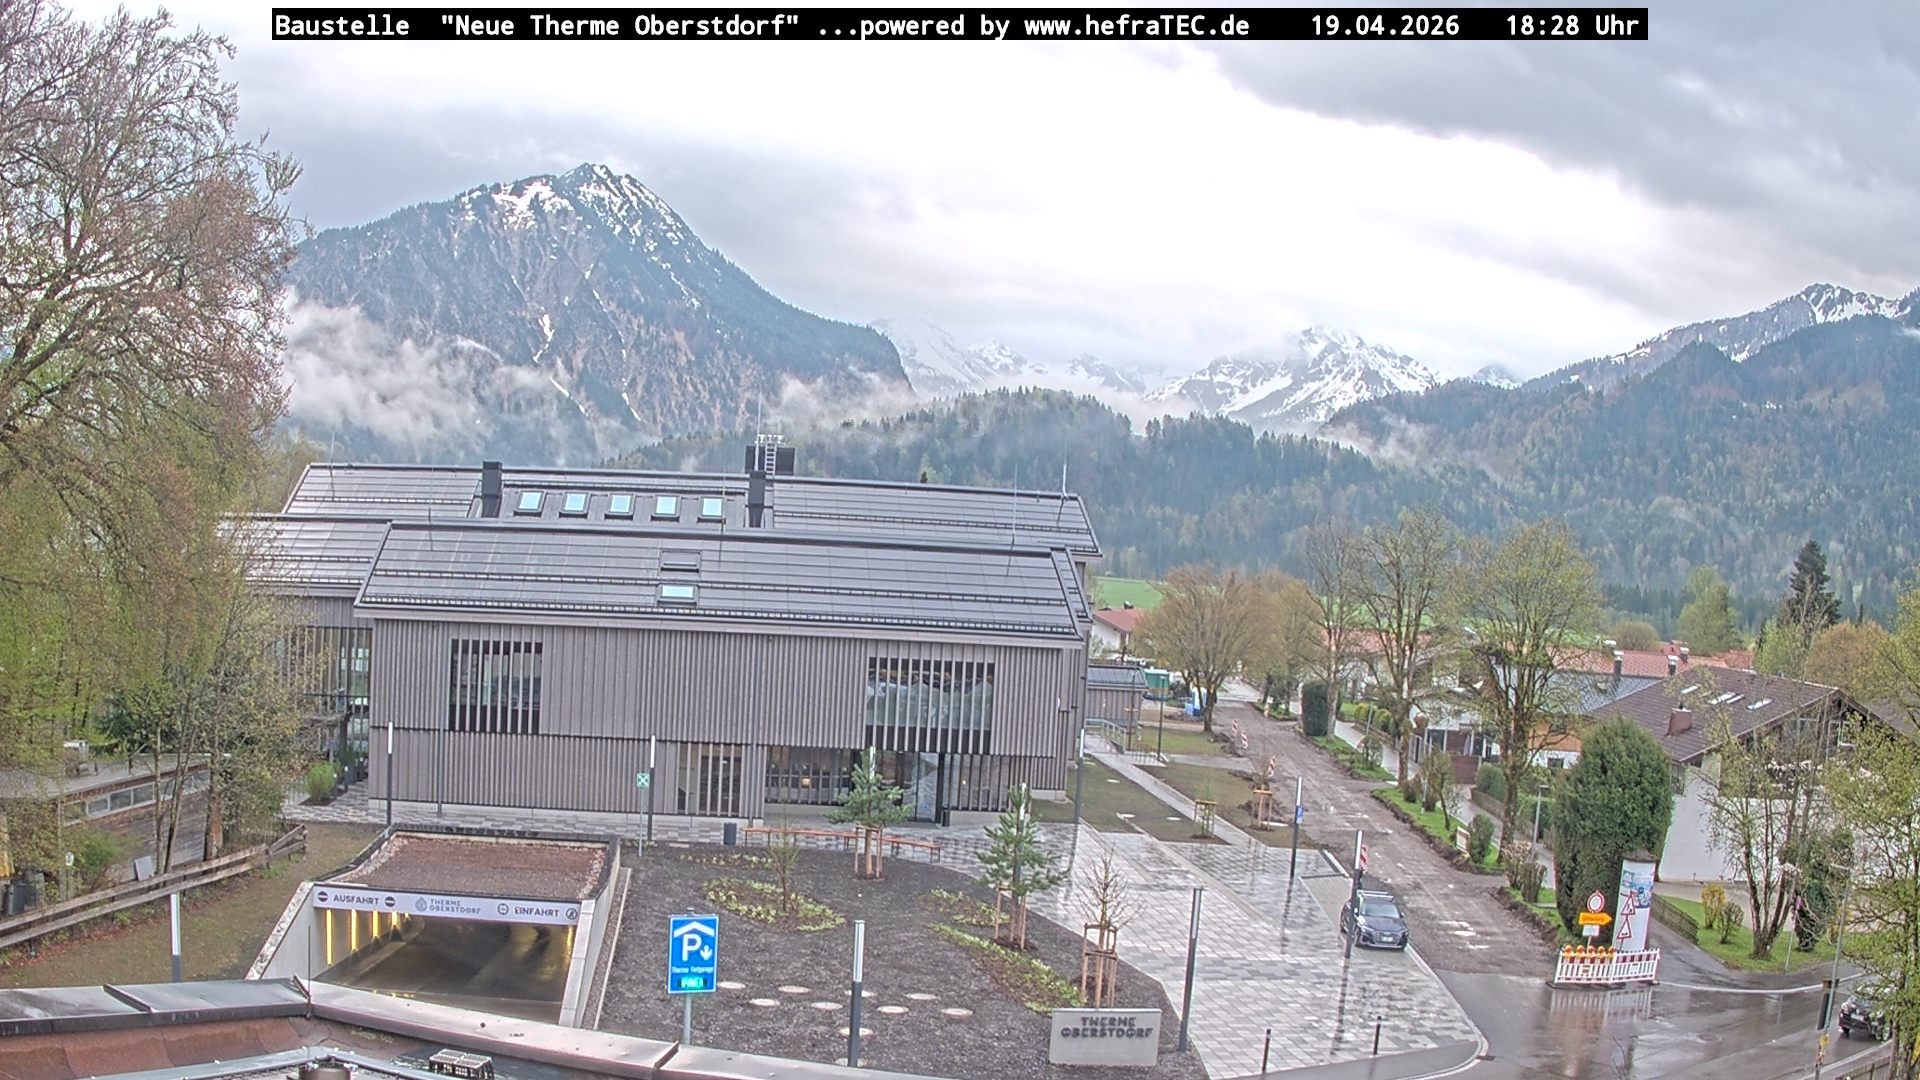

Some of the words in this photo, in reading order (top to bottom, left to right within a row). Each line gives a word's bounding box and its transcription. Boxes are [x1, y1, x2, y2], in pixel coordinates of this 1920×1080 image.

[333, 894, 379, 905] AUSFAHRT
[514, 906, 560, 917] EINFAHRT
[682, 933, 702, 961] P
[1081, 1016, 1137, 1027] THERME
[1060, 1026, 1153, 1038] OBERSTDORF
